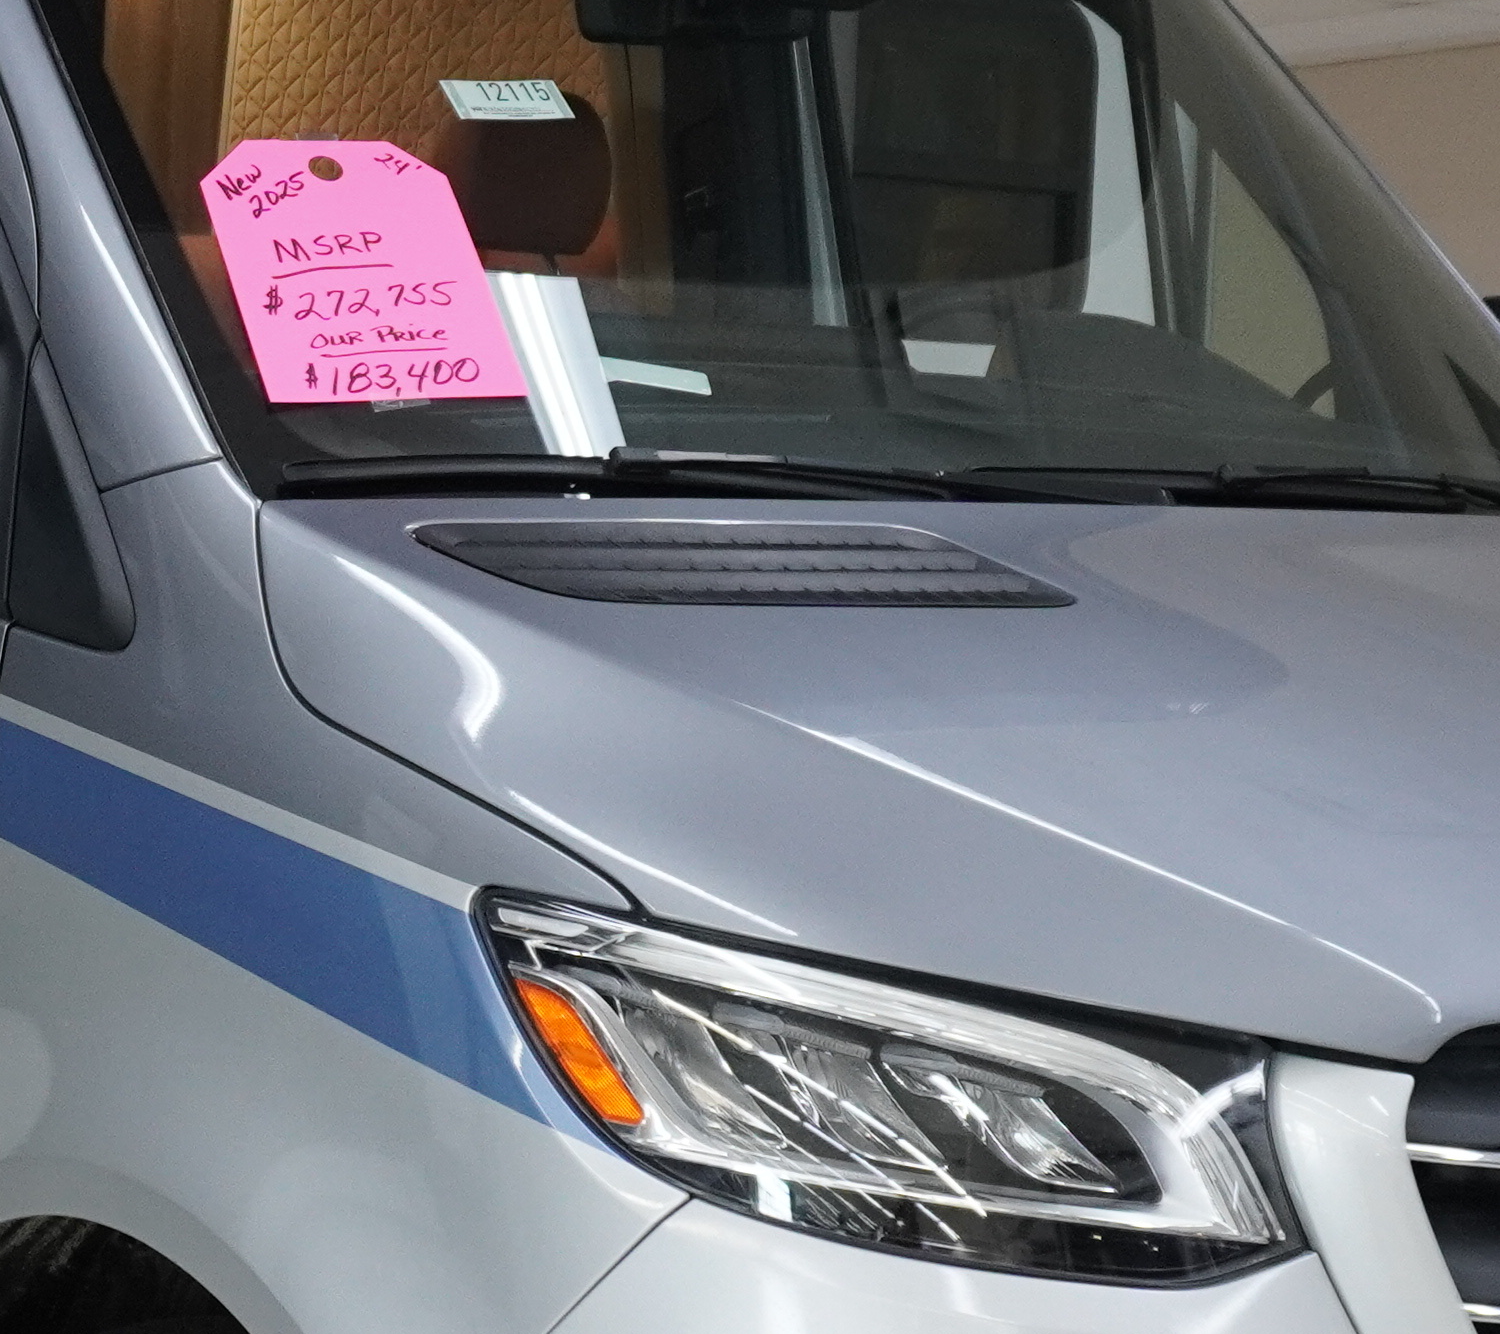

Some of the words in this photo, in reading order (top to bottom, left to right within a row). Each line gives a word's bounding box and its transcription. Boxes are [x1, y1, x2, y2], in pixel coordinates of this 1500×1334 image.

[475, 81, 551, 102] 12115
[215, 164, 262, 200] New
[249, 170, 304, 219] 2025
[272, 231, 382, 263] MSRP
[304, 357, 480, 396] $183,400
